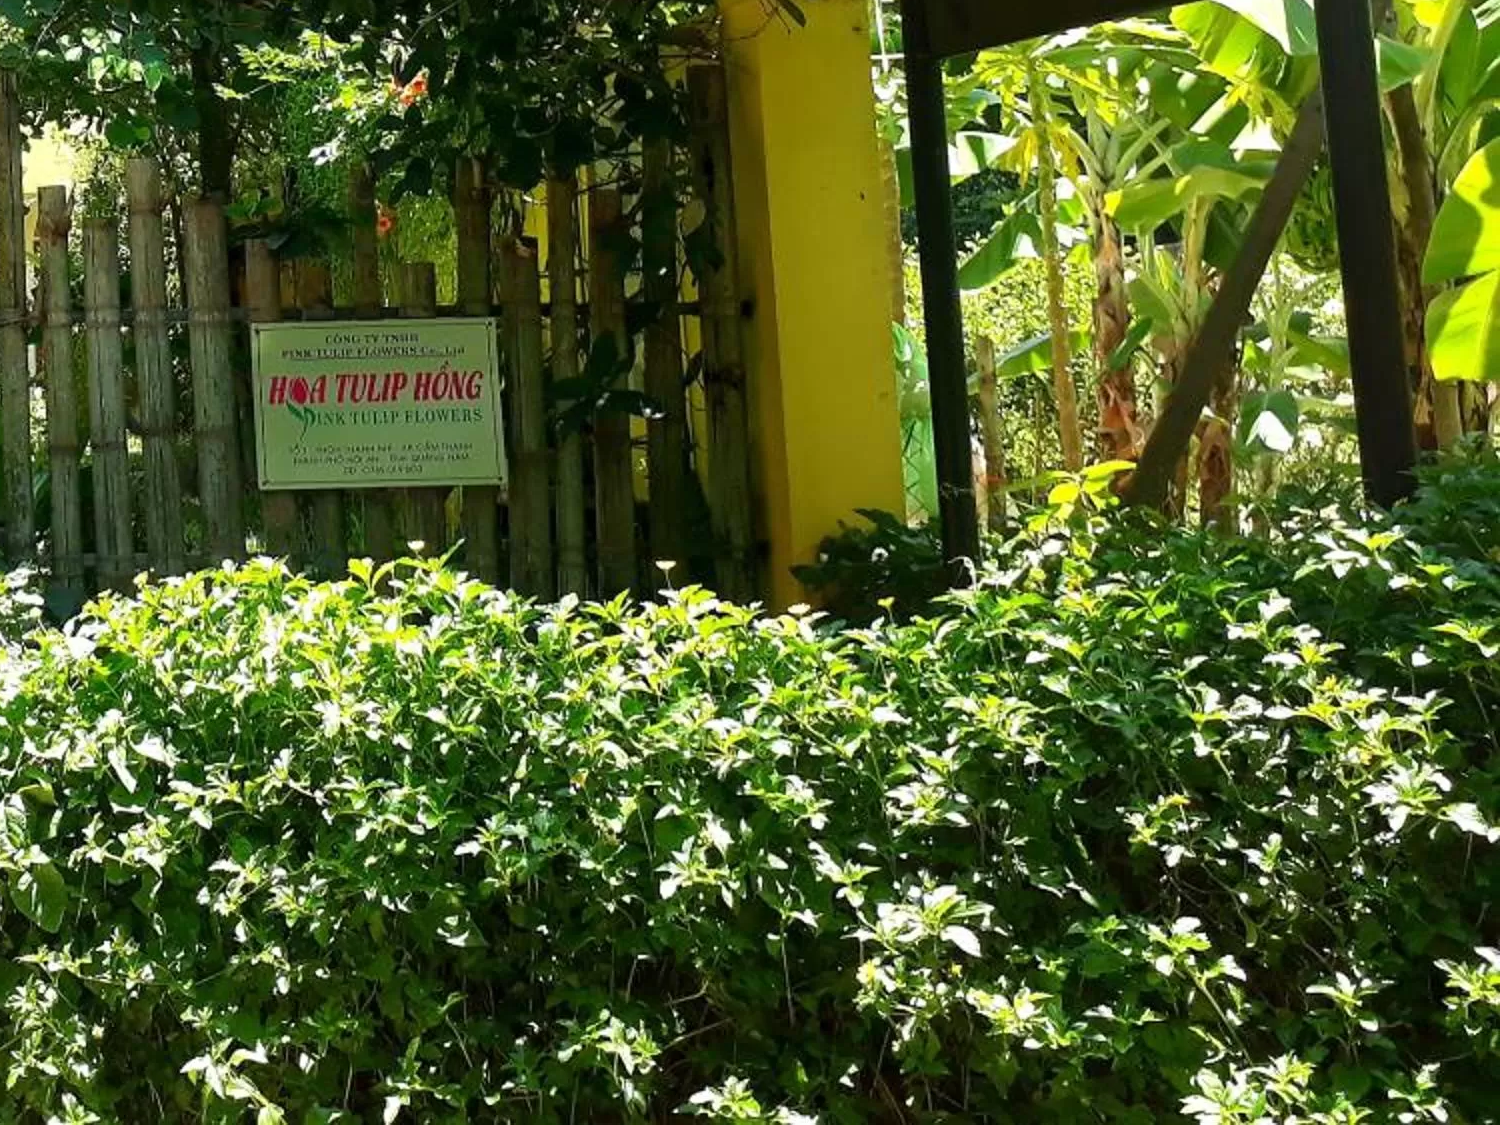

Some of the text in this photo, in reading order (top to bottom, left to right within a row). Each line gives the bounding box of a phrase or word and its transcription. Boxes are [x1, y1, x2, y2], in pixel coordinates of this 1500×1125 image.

[364, 334, 379, 343] TY
[282, 349, 311, 359] PINK
[316, 348, 353, 358] TULIP
[357, 346, 416, 357] FLOWERS
[269, 361, 484, 405] HOA TULIP HỒNG
[351, 411, 398, 426] TULIP
[405, 408, 484, 425] FLOWERS
